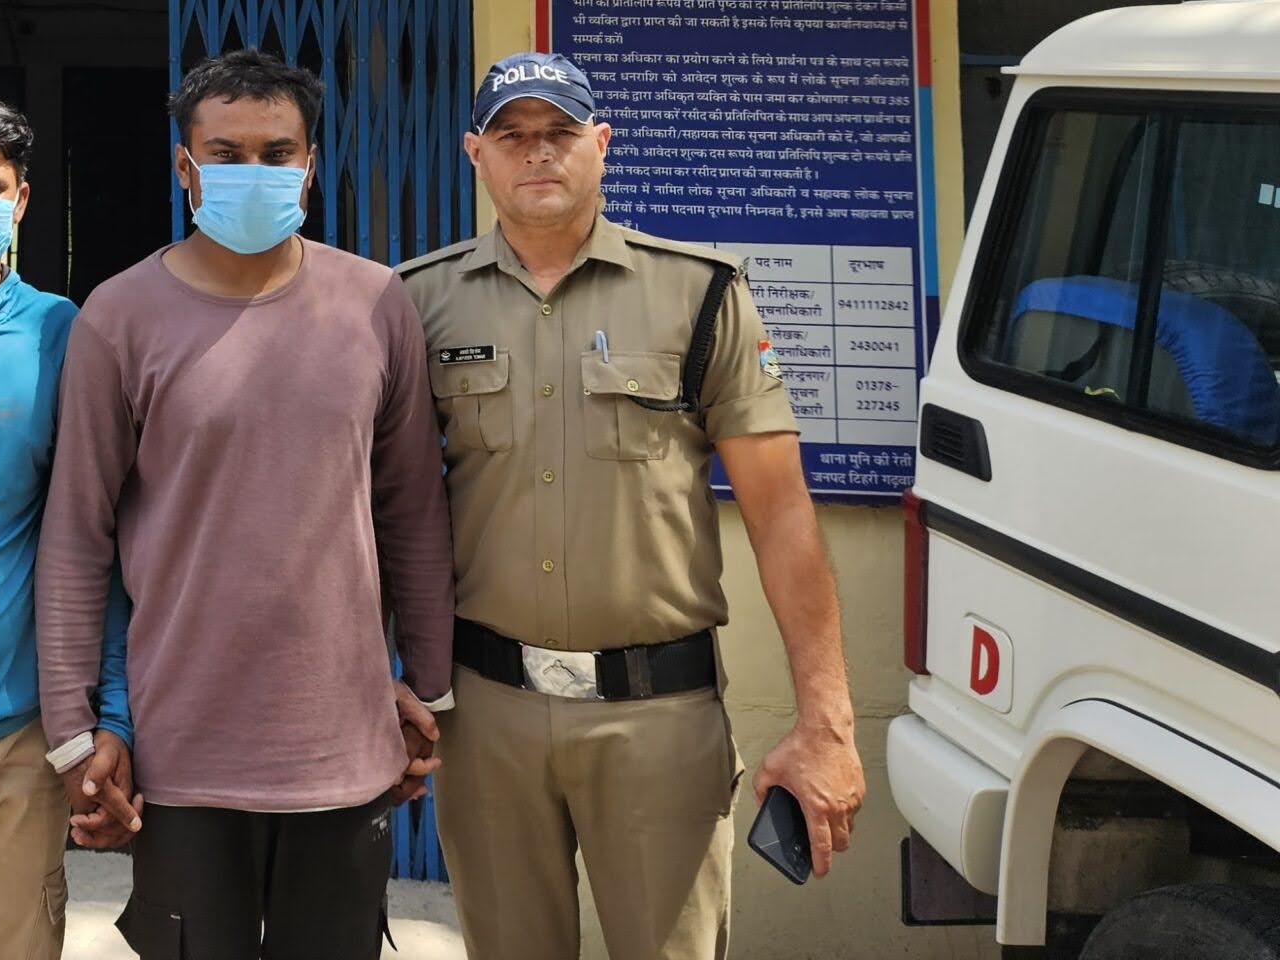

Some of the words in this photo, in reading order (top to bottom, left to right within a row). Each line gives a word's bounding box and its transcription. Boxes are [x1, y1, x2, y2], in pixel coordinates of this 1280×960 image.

[718, 0, 737, 11] पृष्ठ
[588, 14, 619, 25] व्यक्ति
[621, 17, 641, 27] द्वारा
[643, 17, 666, 26] प्राप्त
[667, 15, 682, 26] की
[700, 16, 730, 27] सकती
[741, 16, 768, 29] इसके
[770, 16, 791, 28] लिये
[572, 32, 604, 44] सम्पर्क
[573, 53, 602, 67] सूचना
[604, 54, 619, 62] का
[621, 51, 663, 63] अधिकार
[682, 52, 710, 64] प्रयोग
[712, 53, 735, 64] करने
[751, 53, 773, 65] लिये
[775, 54, 807, 65] प्रार्थना
[492, 64, 571, 92] POLICE
[591, 72, 617, 82] नकद
[621, 70, 658, 81] धनराशि
[681, 71, 717, 83] आवेदन
[721, 75, 748, 88] शुल्क
[606, 88, 630, 100] उनके
[631, 91, 652, 101] द्वारा
[654, 89, 695, 104] अधिकृत
[696, 90, 727, 102] व्यक्ति
[743, 94, 763, 102] पास
[765, 94, 786, 102] जमा
[787, 95, 804, 103] कर
[613, 107, 639, 120] रसीद
[640, 110, 663, 119] प्राप्त
[663, 107, 680, 119] करें
[682, 108, 707, 120] रसीद
[721, 127, 746, 139] लोक
[748, 131, 777, 142] सूचना
[780, 129, 826, 141] अधिकारी
[642, 145, 678, 157] आवेदन
[680, 149, 708, 162] शुल्क
[709, 149, 725, 159] दस
[756, 150, 776, 159] तथा
[778, 148, 821, 160] प्रतिलिपि
[624, 166, 650, 176] नकद
[652, 167, 671, 175] जमा
[674, 168, 690, 176] कर
[692, 165, 717, 177] रसीद
[719, 168, 741, 177] प्राप्त
[773, 167, 803, 178] सकती
[654, 183, 684, 195] नामित
[688, 184, 712, 195] लोक
[717, 187, 746, 199] सूचना
[751, 185, 797, 197] अधिकारी
[650, 205, 669, 213] नाम
[671, 205, 705, 215] पदनाम
[755, 258, 770, 268] पद
[773, 258, 792, 267] नाम
[838, 300, 909, 311] 9411112842
[850, 341, 900, 352] 2430041
[857, 400, 900, 411] 227245
[820, 453, 846, 465] थाना
[849, 452, 870, 468] मुनि
[873, 451, 889, 466] की
[894, 452, 912, 467] रेती
[811, 472, 846, 485] जनपद
[849, 471, 878, 485] टिहरी
[882, 472, 915, 488] गढ़वा
[970, 624, 1000, 695] D
